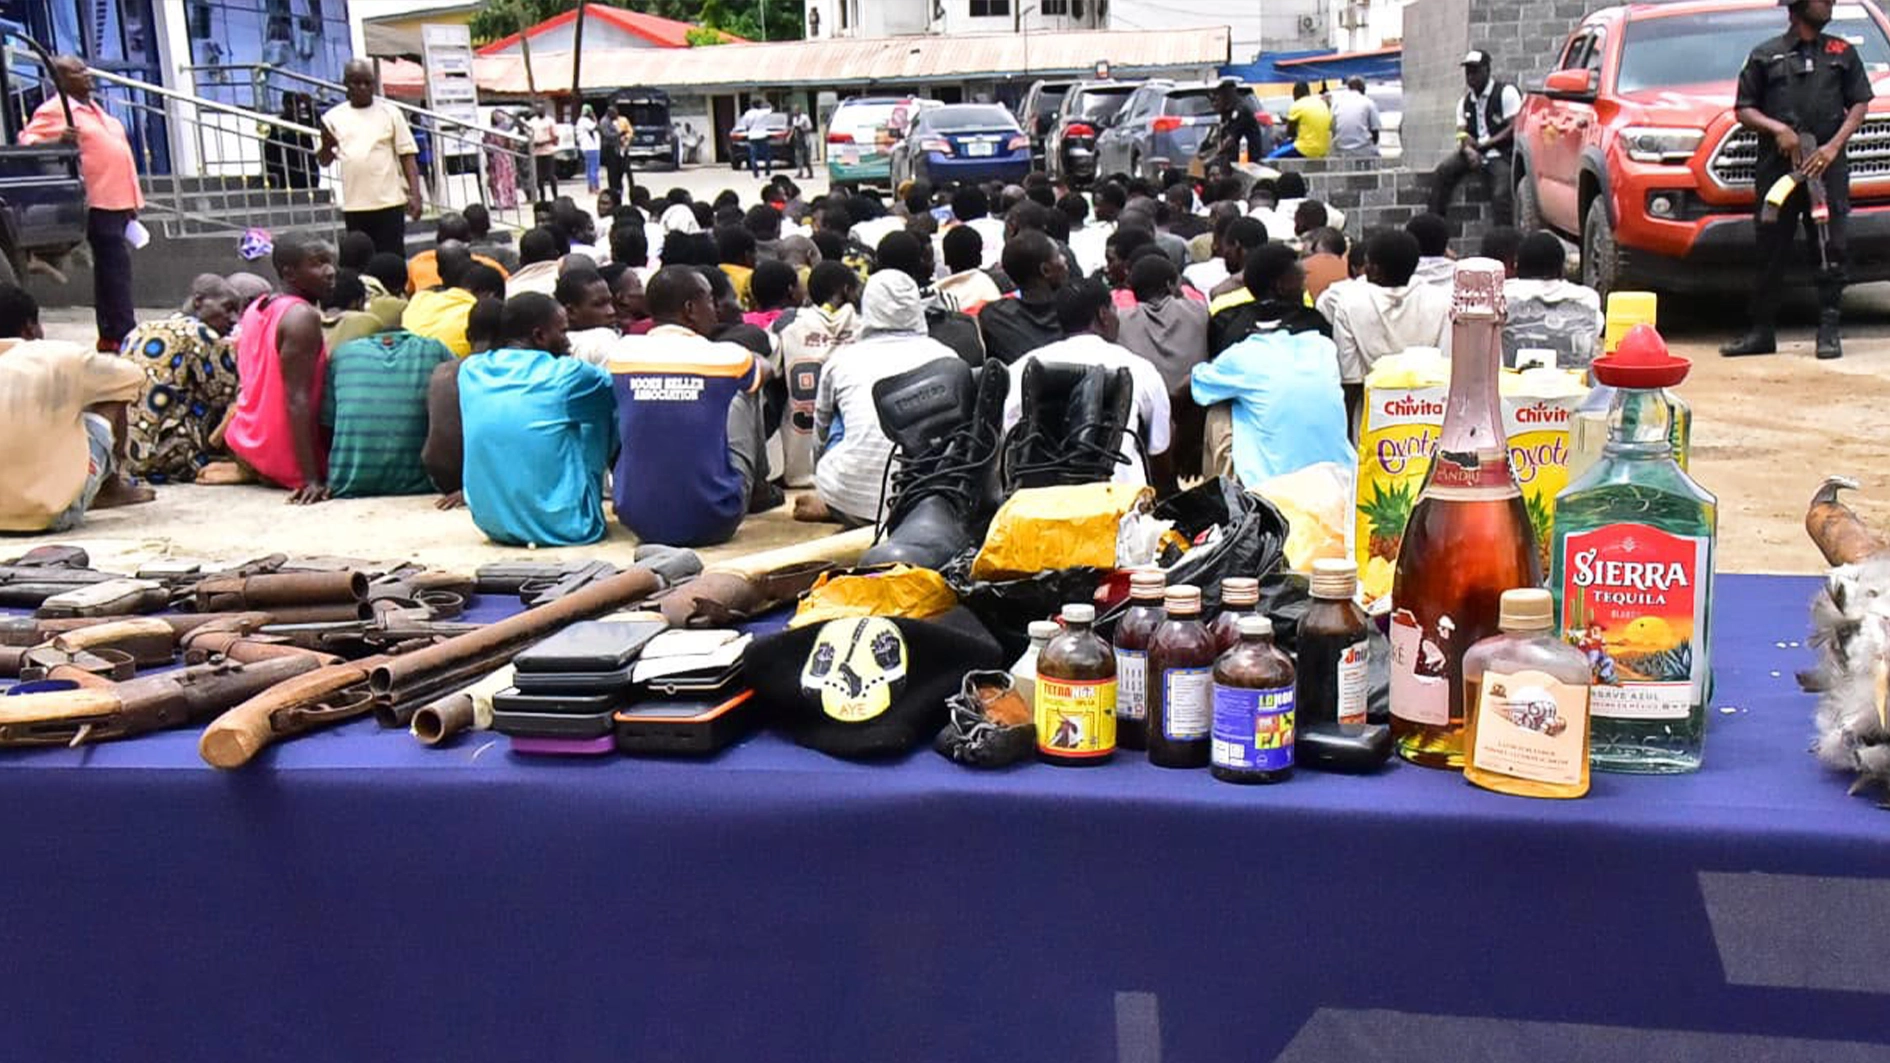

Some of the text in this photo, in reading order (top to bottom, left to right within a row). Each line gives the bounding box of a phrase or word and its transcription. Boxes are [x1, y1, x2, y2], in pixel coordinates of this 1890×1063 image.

[1384, 394, 1443, 416] Chivita
[1515, 402, 1570, 423] Chivit
[1377, 430, 1439, 475] exoti
[1572, 548, 1688, 591] SIERRA
[1593, 590, 1667, 606] TEQUILA
[838, 703, 867, 716] AYE
